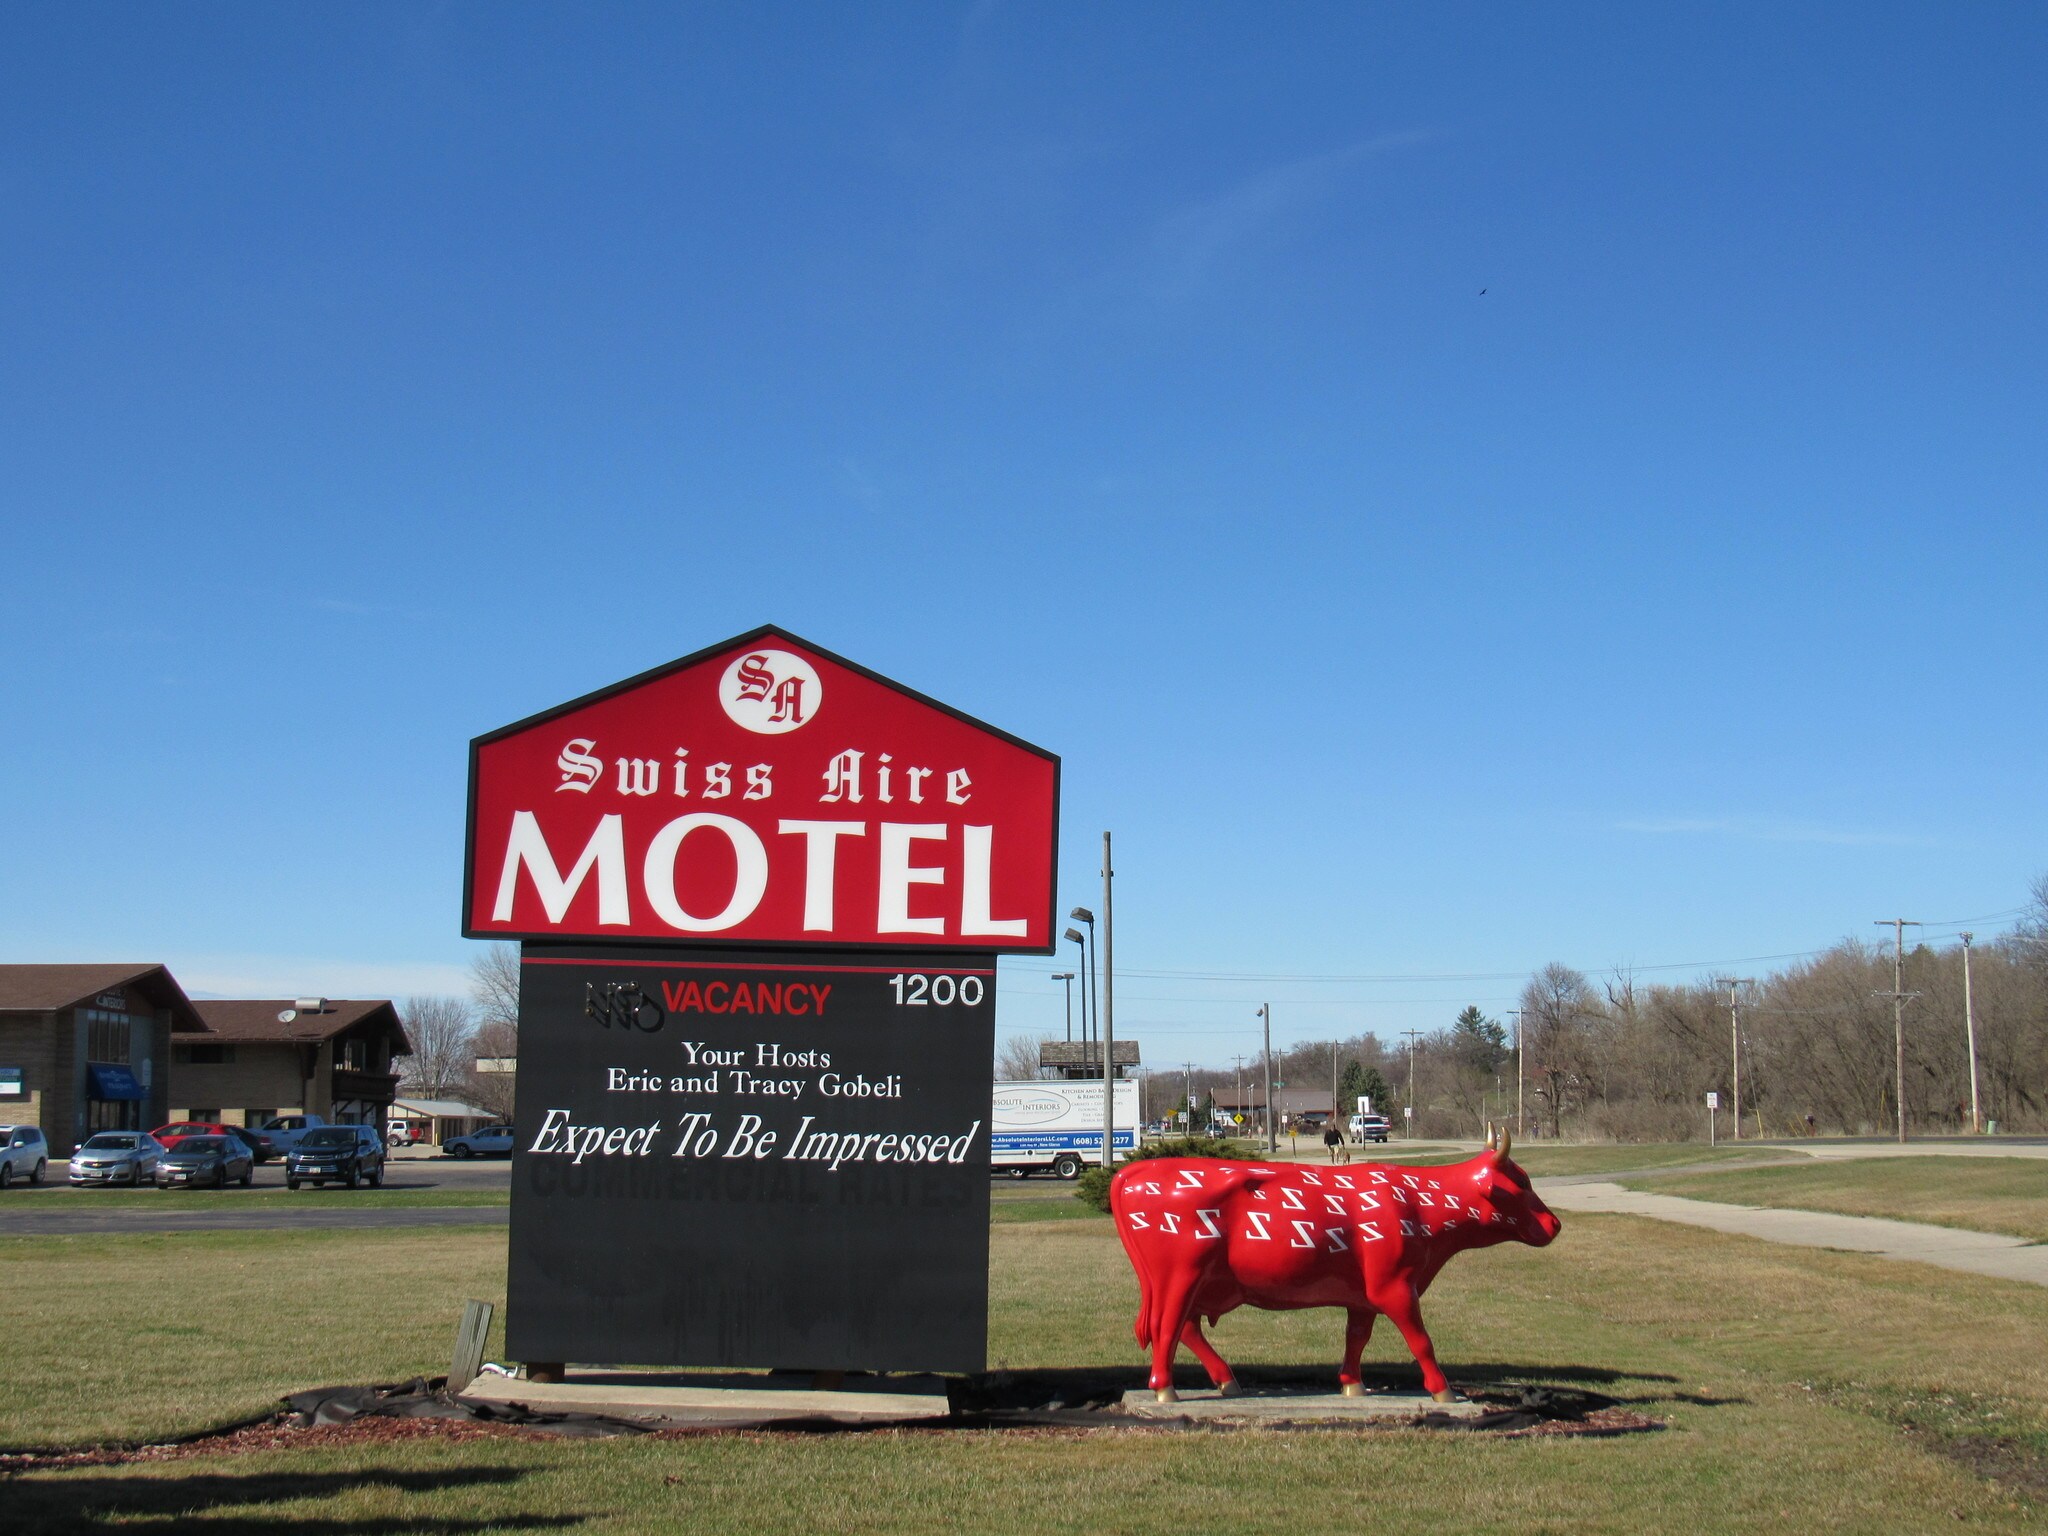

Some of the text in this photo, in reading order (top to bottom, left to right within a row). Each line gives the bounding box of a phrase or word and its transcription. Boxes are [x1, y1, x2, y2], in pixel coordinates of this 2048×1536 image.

[555, 738, 972, 805] Swiss Aire
[492, 810, 1027, 937] MOTEL
[661, 980, 832, 1016] VACANCY
[889, 973, 984, 1006] 1200
[681, 1041, 831, 1069] Your Hosts
[606, 1067, 902, 1100] Eric and Tracy Gobeli
[993, 1098, 1061, 1111] BSOLUTE INTERIORS
[528, 1109, 981, 1171] Expect To Be Impressed
[1073, 1137, 1093, 1146] (608)
